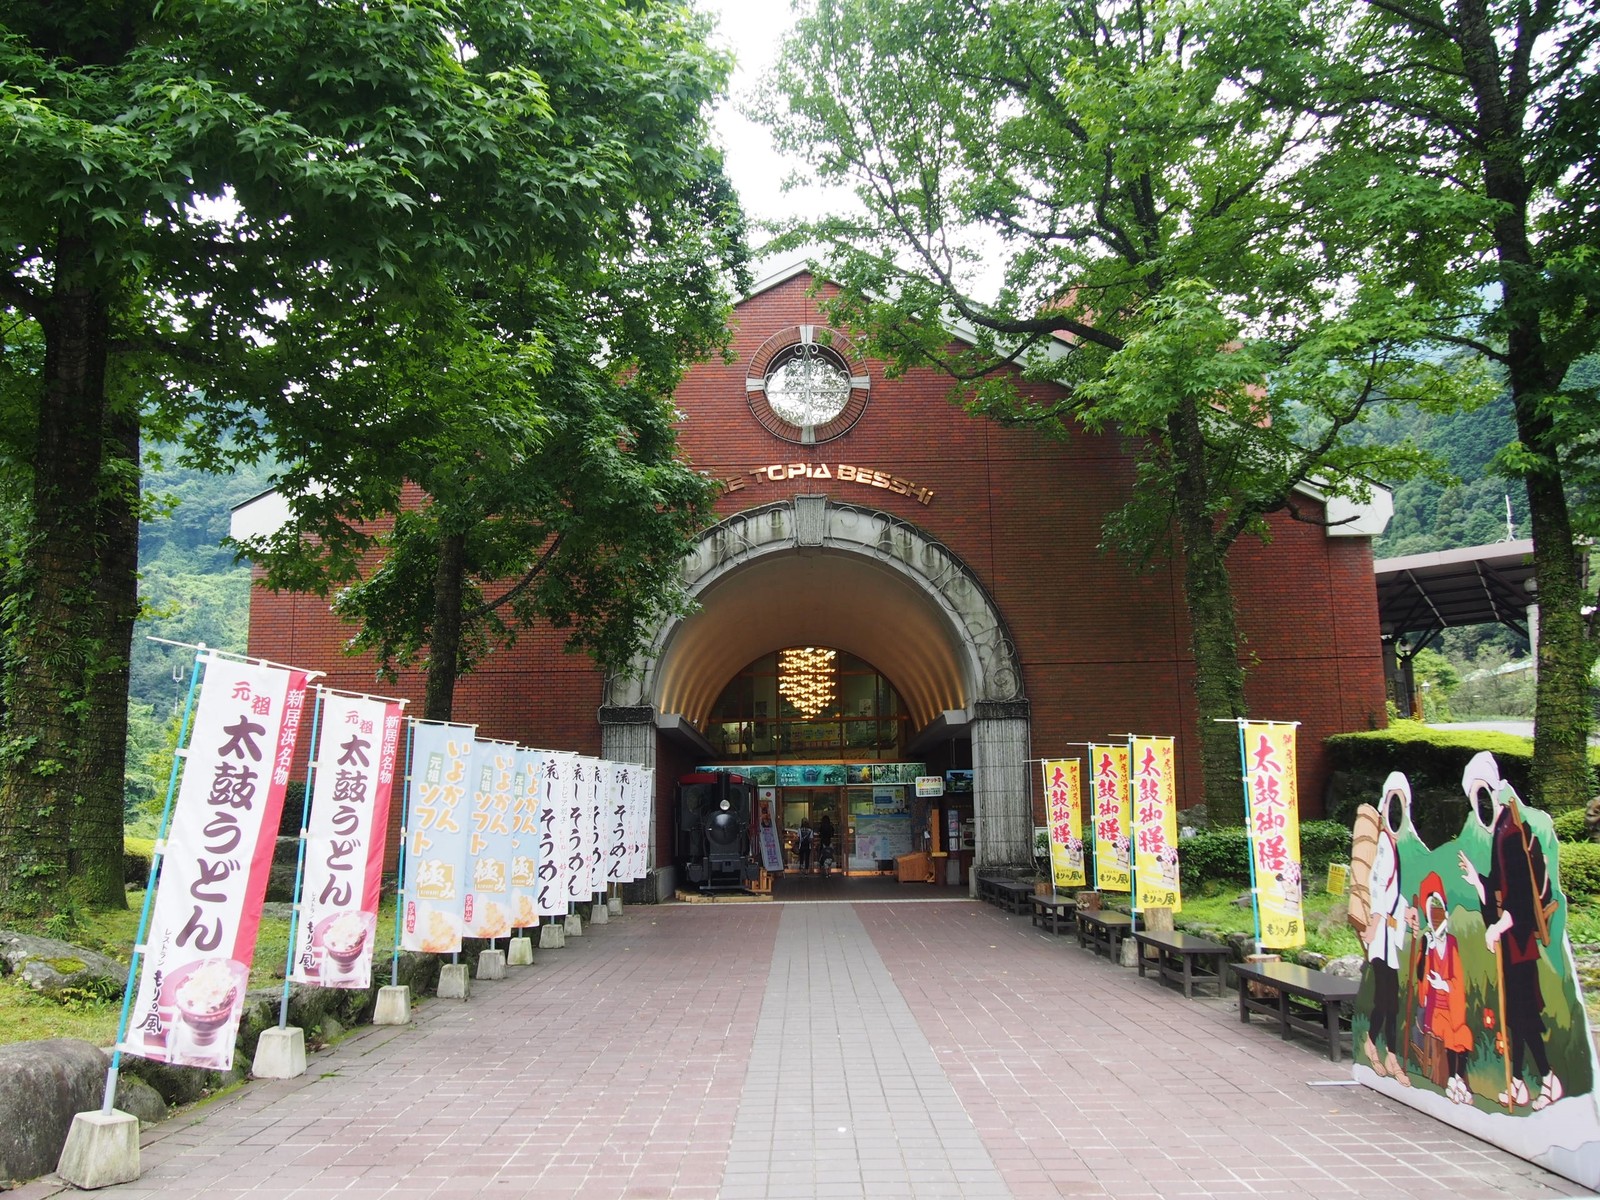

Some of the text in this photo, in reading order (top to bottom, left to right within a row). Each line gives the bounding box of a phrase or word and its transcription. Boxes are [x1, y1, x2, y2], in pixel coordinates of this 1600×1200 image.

[231, 681, 271, 717] 元祖
[344, 709, 374, 735] 元祖
[273, 688, 305, 786] 新居浜名物
[379, 715, 399, 785] 新居浜名物
[427, 755, 442, 784] 元祖
[436, 740, 470, 833] いよかん
[481, 768, 492, 793] 元祖
[490, 755, 514, 835] いよかん
[521, 762, 541, 835] いよかん
[1049, 767, 1071, 844] 太鼓御膳
[1096, 753, 1120, 841] 太鼓御膳
[1136, 747, 1166, 854] 太鼓御膳
[1250, 735, 1288, 871] 太鼓御膳
[175, 714, 265, 952] 太鼓うどん
[318, 733, 371, 907] 太鼓うどん
[413, 783, 440, 856] ソフト
[470, 792, 492, 856] ソフト
[538, 759, 560, 909] 流しそうめん
[608, 769, 630, 878] 流しそうめん
[416, 859, 455, 899] 極み
[1141, 892, 1176, 906] もりの風
[158, 928, 172, 966] レストラン
[299, 921, 315, 967] もりの風
[136, 969, 163, 1033] もりの風
